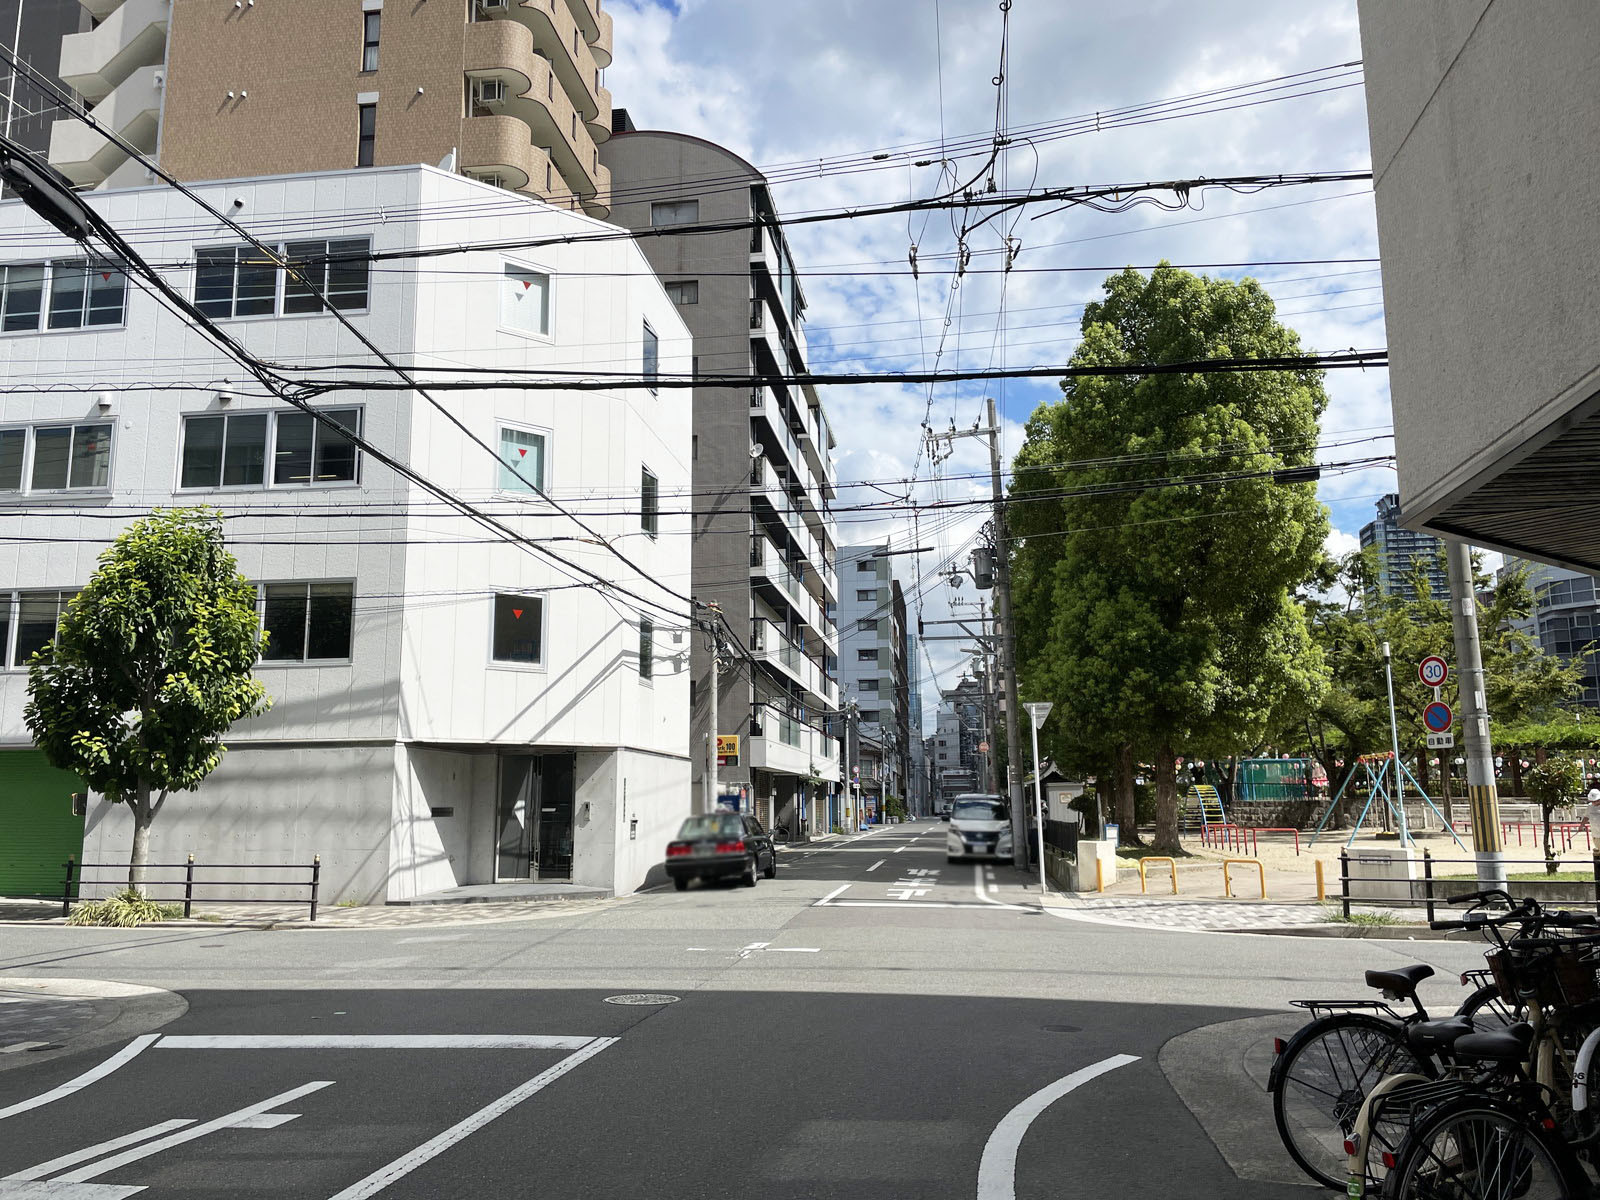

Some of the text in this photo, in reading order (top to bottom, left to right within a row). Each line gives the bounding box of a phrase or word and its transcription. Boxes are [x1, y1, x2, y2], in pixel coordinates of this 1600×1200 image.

[1425, 665, 1441, 678] 30
[1428, 737, 1451, 745] 自動車
